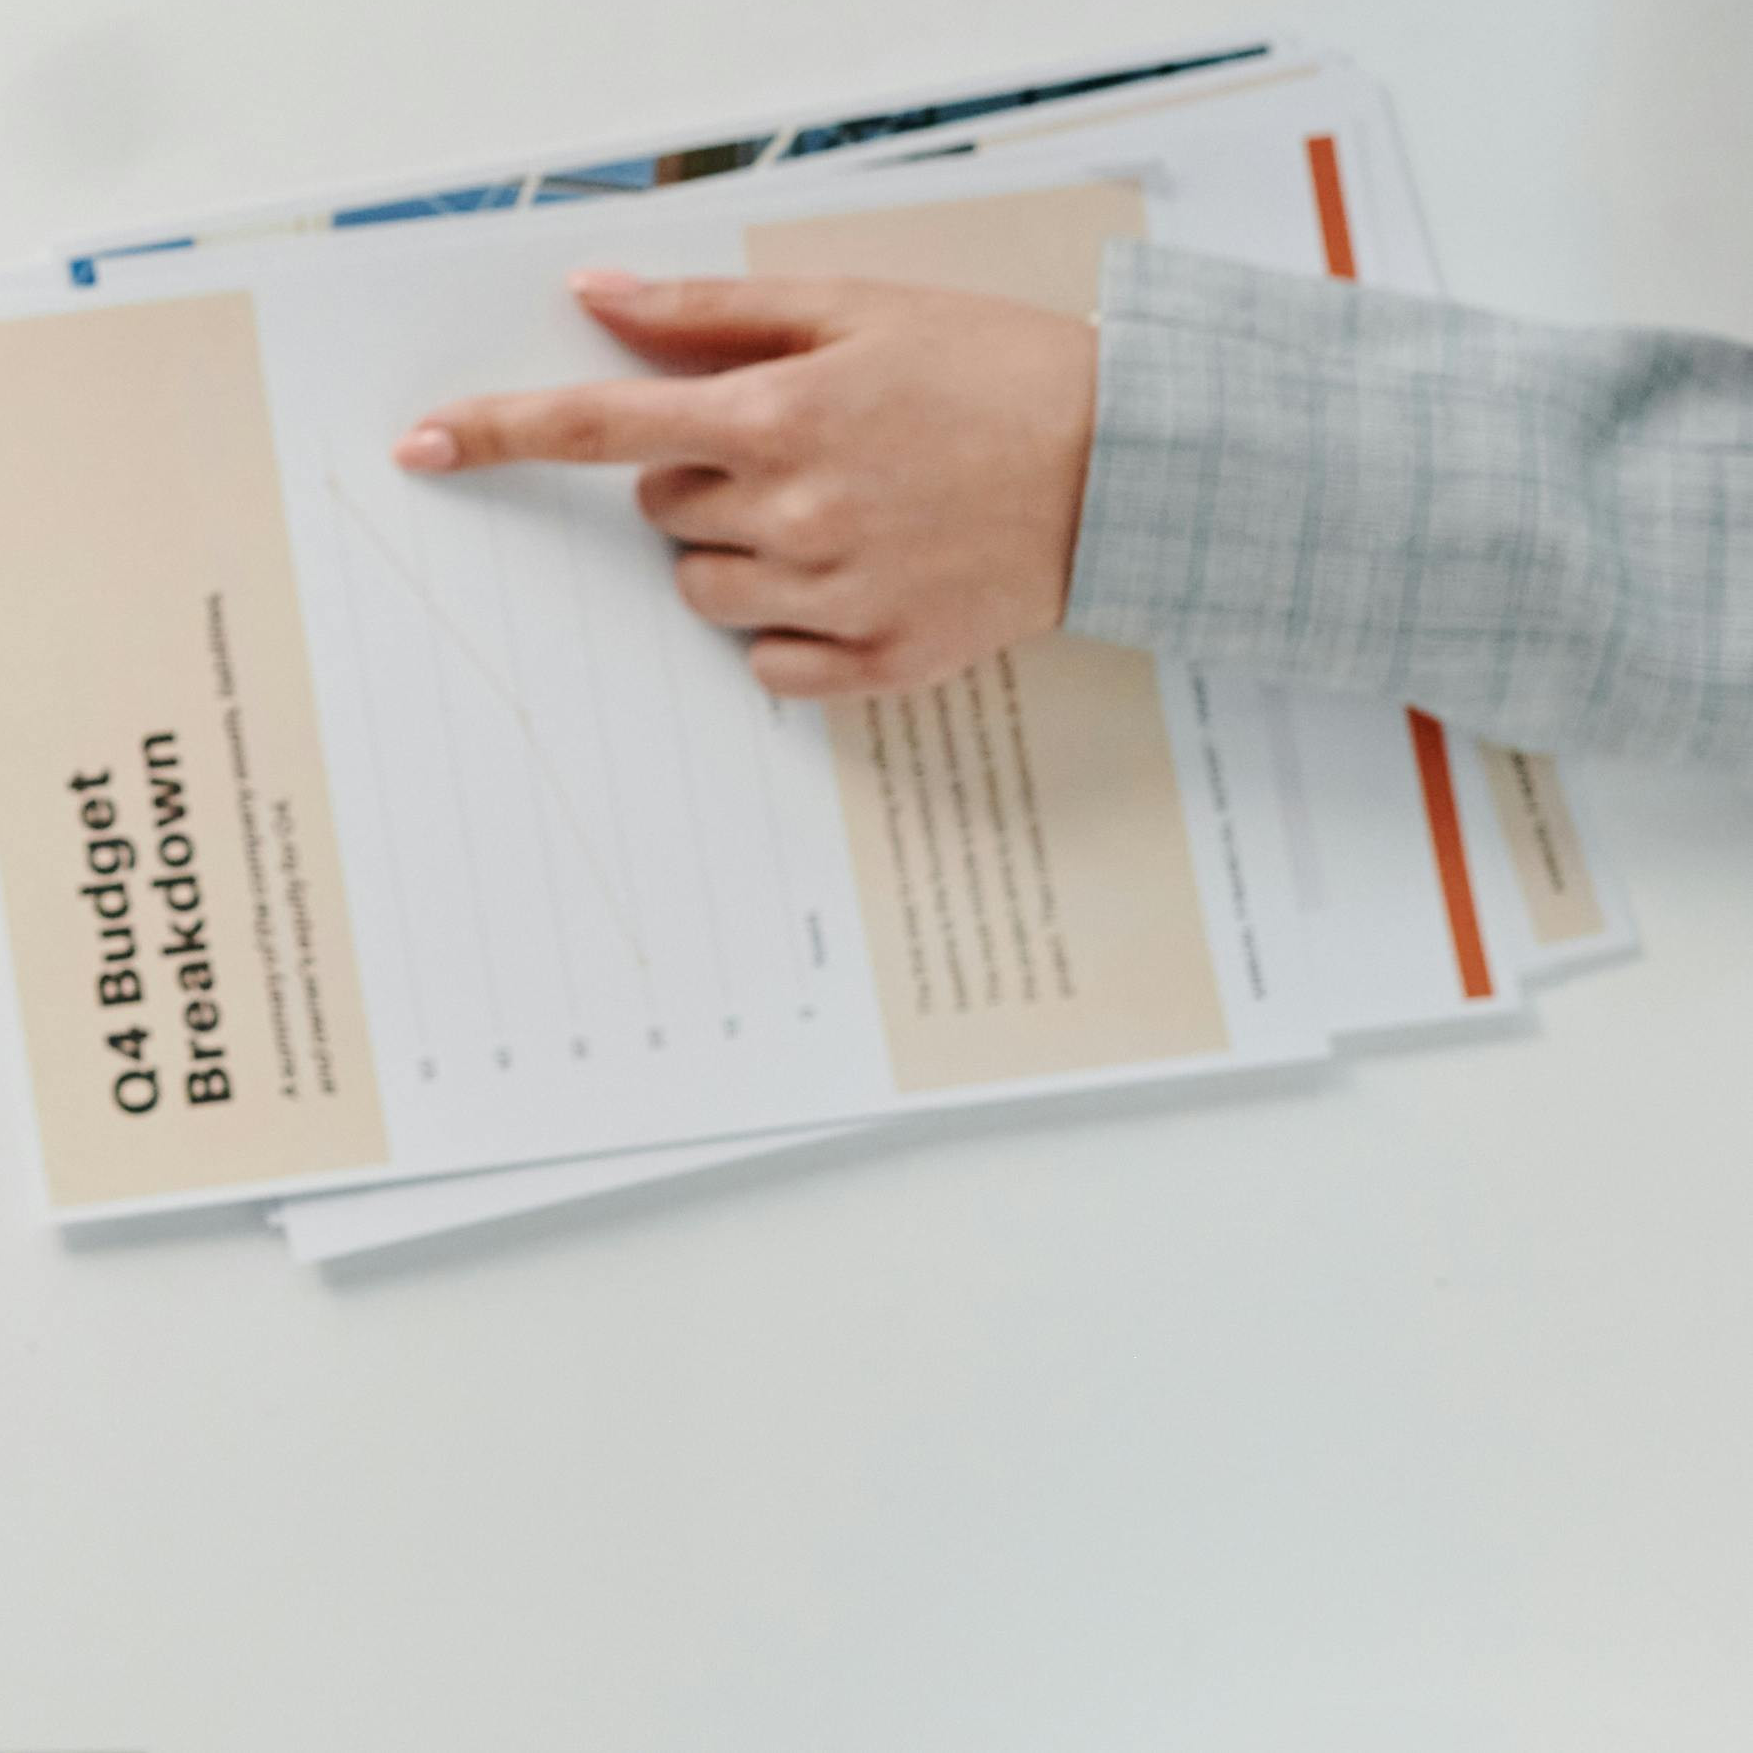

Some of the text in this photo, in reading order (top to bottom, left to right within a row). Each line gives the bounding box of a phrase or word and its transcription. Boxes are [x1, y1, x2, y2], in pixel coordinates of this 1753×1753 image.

[65, 768, 162, 1116] Q4 Budget
[141, 730, 234, 1108] Breakdown
